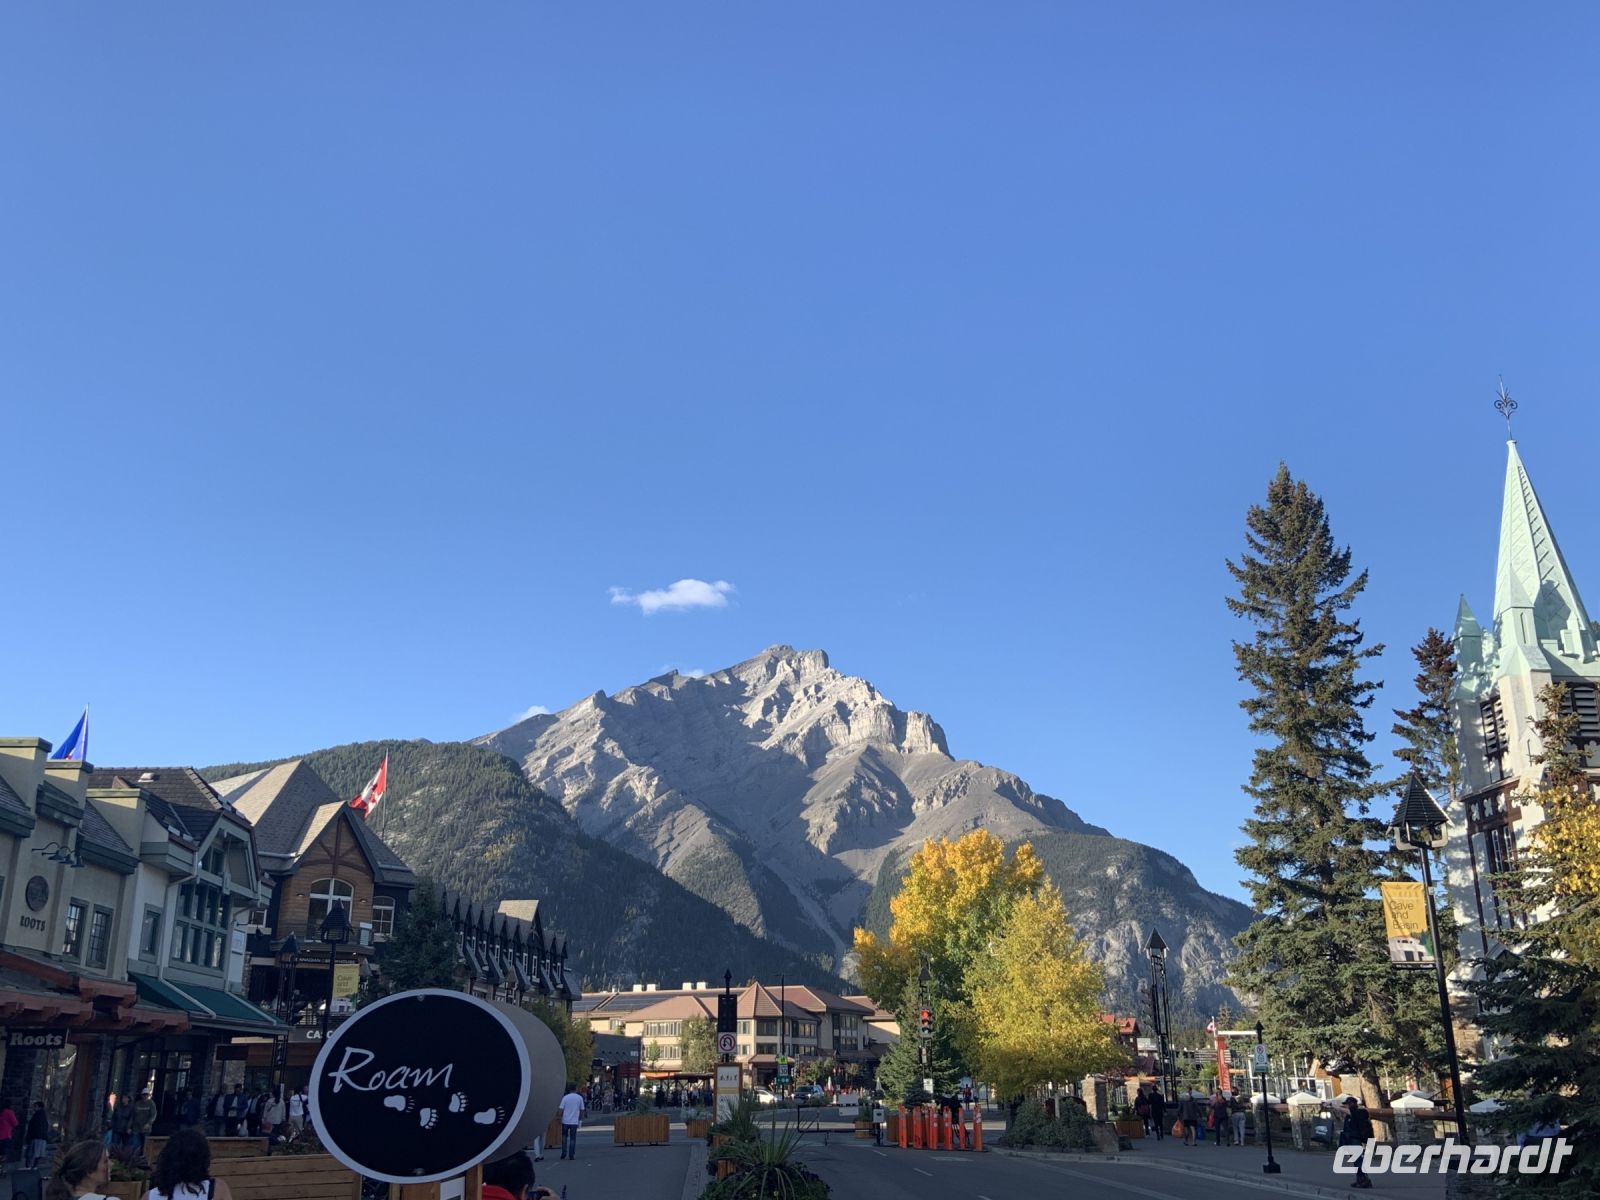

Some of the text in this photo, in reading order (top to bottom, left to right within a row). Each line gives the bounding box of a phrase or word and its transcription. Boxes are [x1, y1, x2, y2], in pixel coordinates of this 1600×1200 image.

[1390, 900, 1414, 910] Cave
[1392, 911, 1409, 919] and
[1393, 919, 1419, 930] Basin
[9, 1032, 63, 1046] Roots
[327, 1046, 453, 1093] Roam
